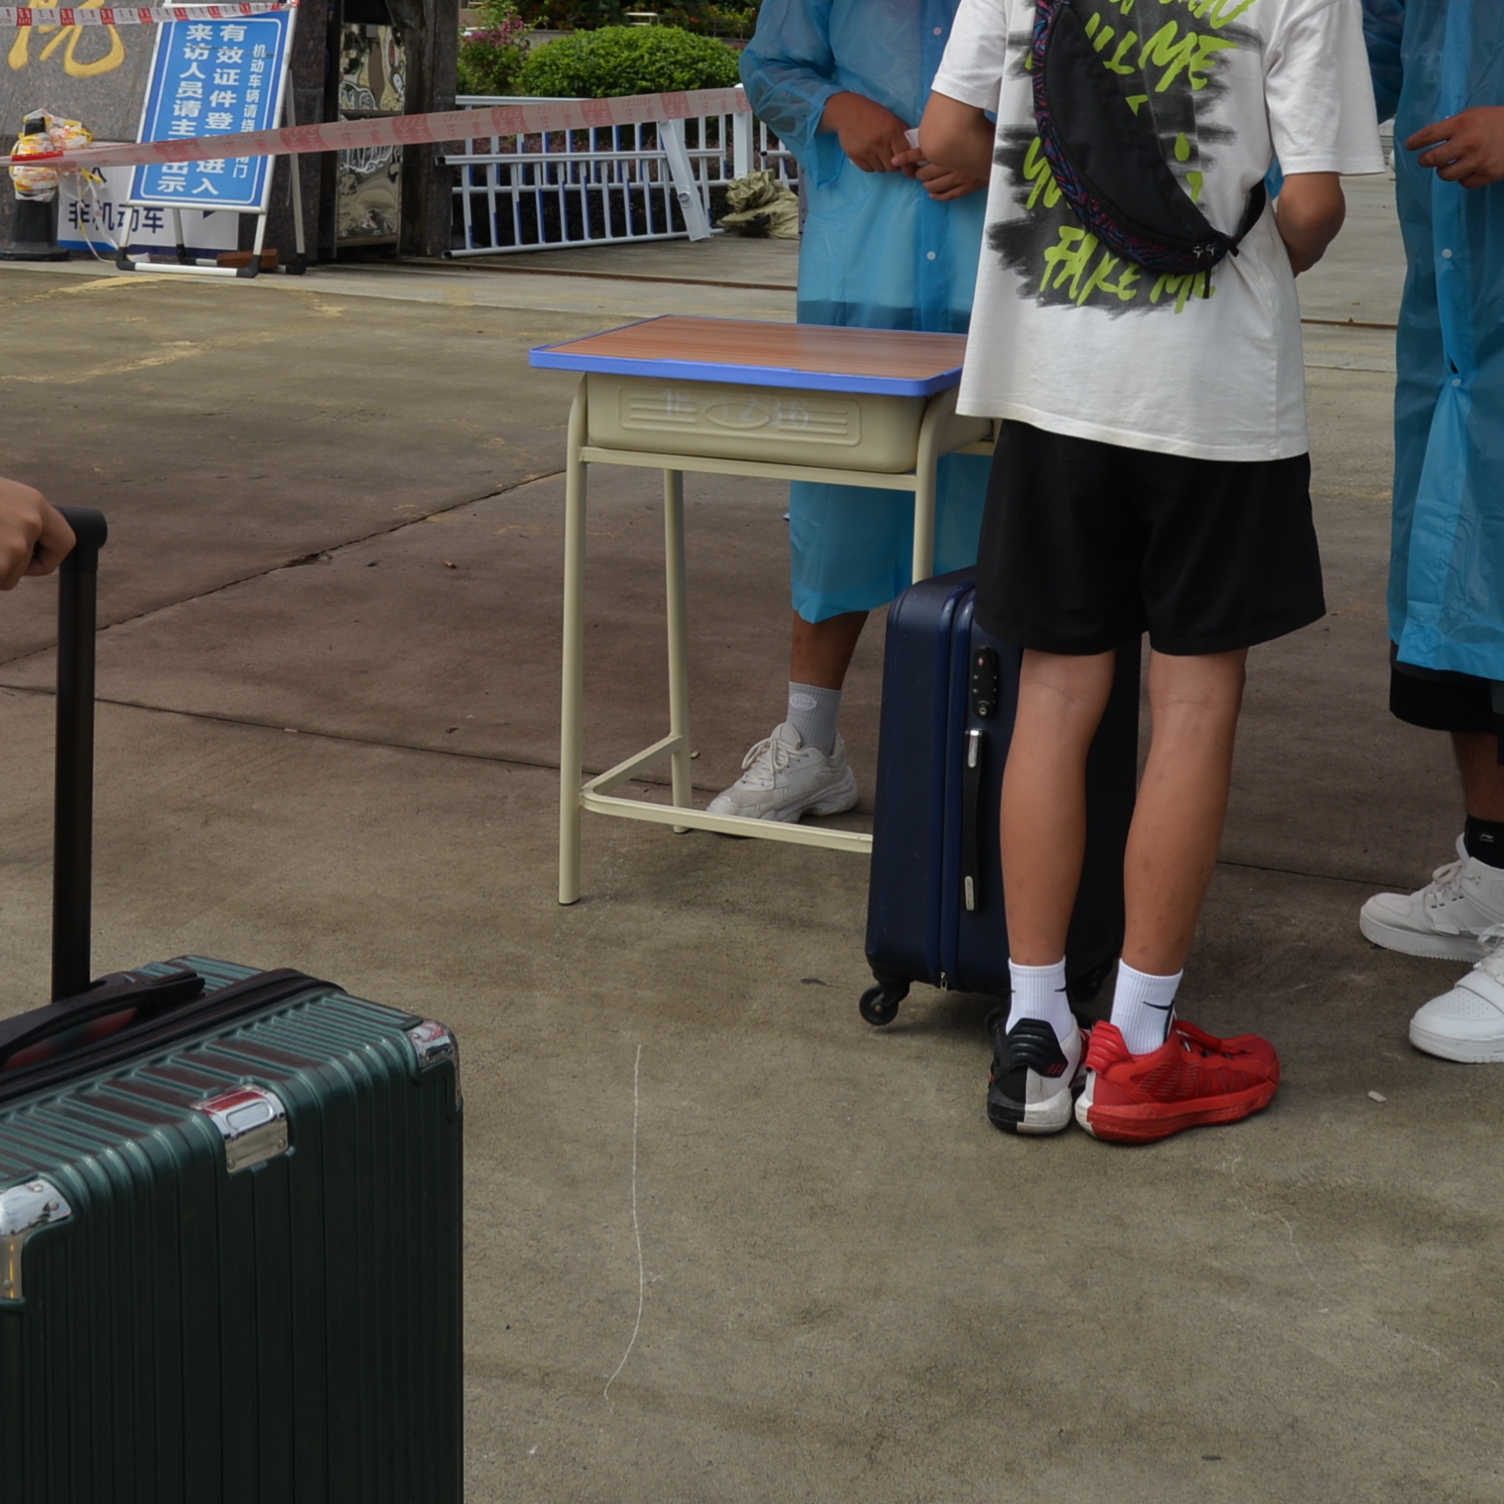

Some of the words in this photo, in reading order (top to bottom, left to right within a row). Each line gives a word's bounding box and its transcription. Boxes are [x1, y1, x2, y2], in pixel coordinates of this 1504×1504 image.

[157, 24, 213, 194] 来访人员请主出示
[192, 24, 248, 196] 有效证件登进入
[233, 44, 267, 179] 机动车辆请绕门
[1138, 20, 1239, 93] ME
